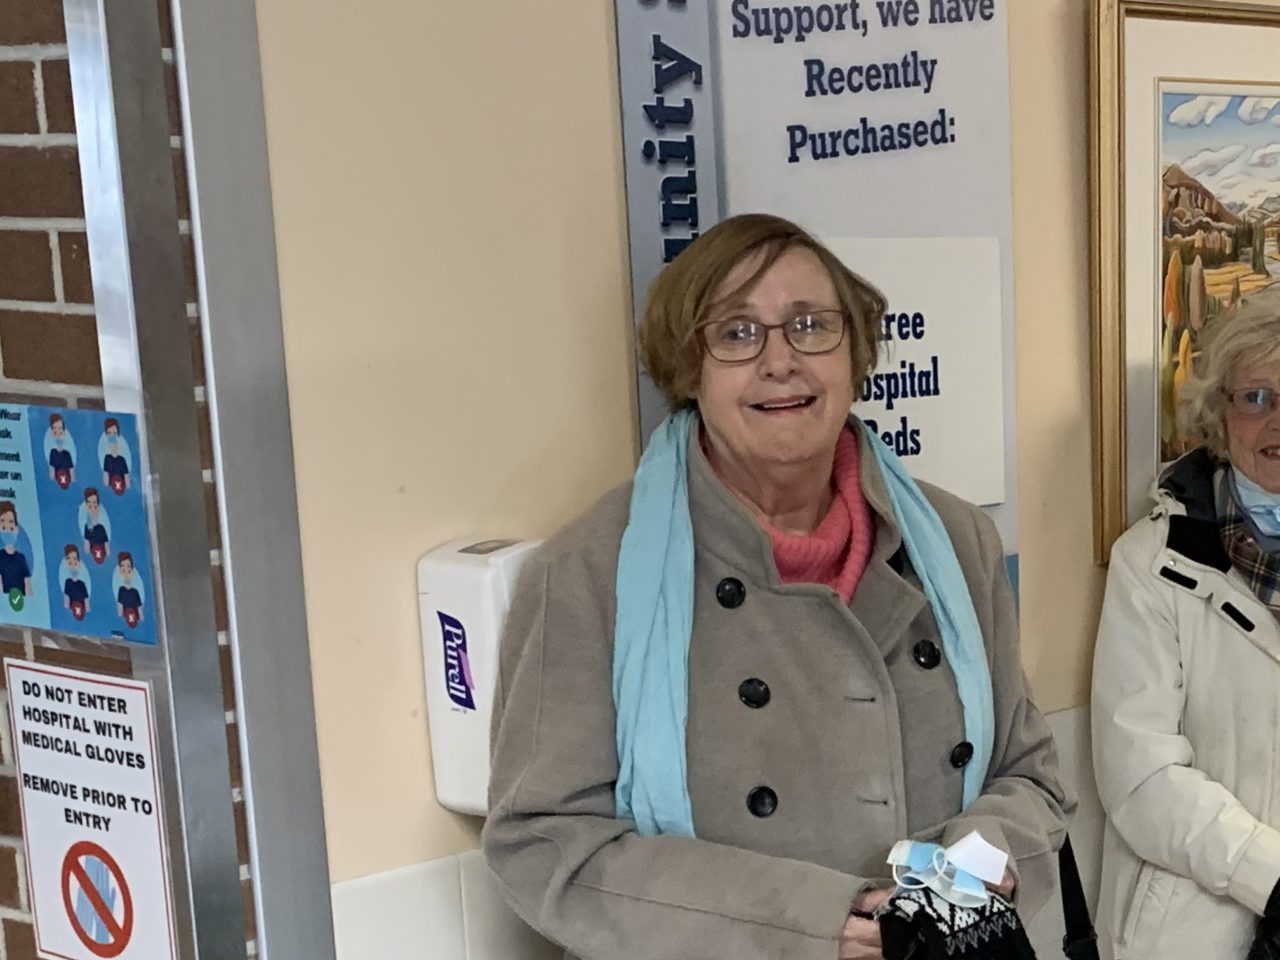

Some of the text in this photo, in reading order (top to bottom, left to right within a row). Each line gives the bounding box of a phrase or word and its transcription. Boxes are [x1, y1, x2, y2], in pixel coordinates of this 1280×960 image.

[731, 0, 869, 43] Support,
[876, 0, 920, 27] we
[803, 51, 938, 97] Recently
[786, 108, 956, 163] Purchased:
[877, 312, 925, 341] ree
[860, 355, 940, 410] ospital
[444, 621, 467, 700] Purell
[22, 680, 128, 715] DO NOT ENTER
[22, 705, 134, 742] HOSPITAL WITH
[21, 730, 146, 770] MEDICAL GLOVES
[22, 773, 153, 816] REMOVE PRIOR TO
[64, 807, 112, 832] ENTRY
